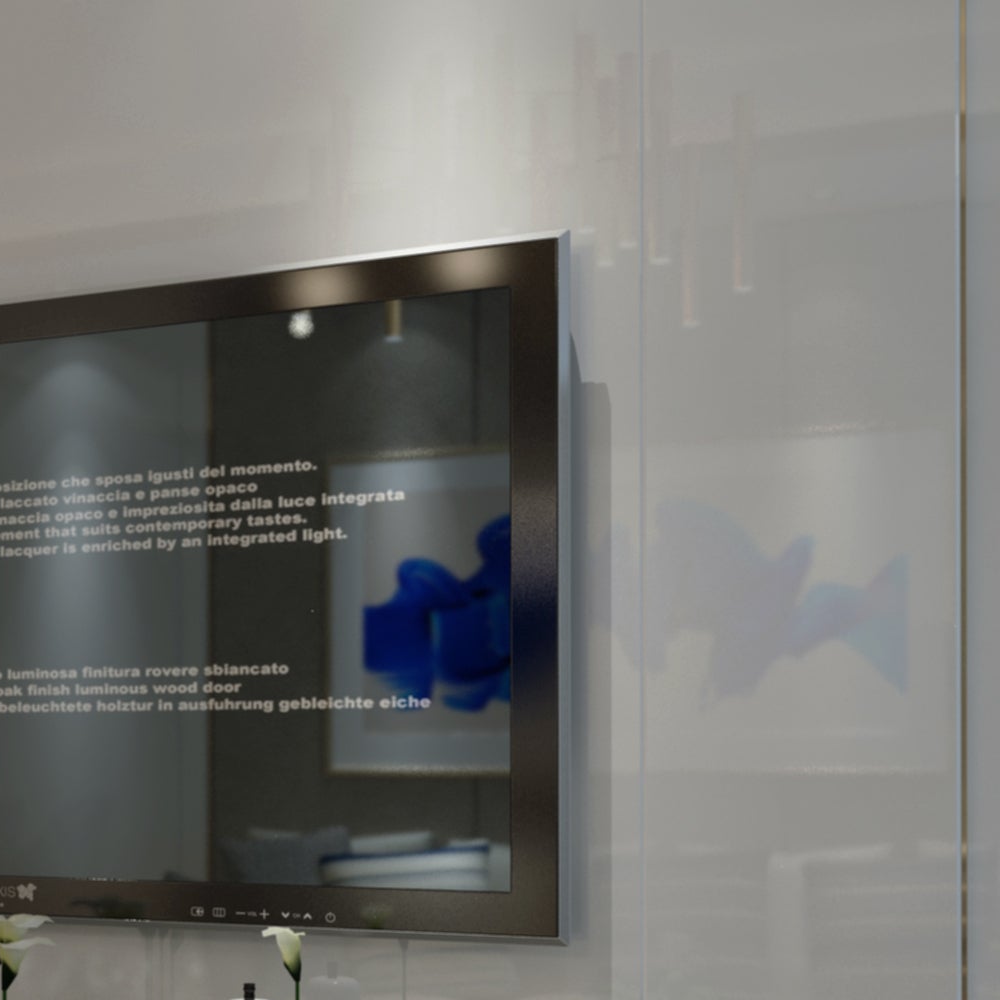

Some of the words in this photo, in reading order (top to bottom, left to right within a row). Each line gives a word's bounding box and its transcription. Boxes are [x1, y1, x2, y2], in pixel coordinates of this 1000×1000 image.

[62, 476, 90, 488] che
[95, 473, 143, 488] sposa
[199, 466, 226, 479] del
[230, 461, 318, 477] momento.
[0, 496, 58, 509] laccato
[63, 490, 130, 504] vinaccia
[135, 490, 145, 500] e
[150, 486, 200, 502] panse
[205, 482, 258, 498] opaco
[55, 510, 103, 524] opaco
[108, 509, 118, 519] e
[123, 501, 225, 519] impreziosita
[230, 498, 273, 512] dalla
[278, 496, 316, 508] luce
[321, 490, 405, 506] integrata
[45, 525, 76, 538] that
[82, 524, 121, 536] suits
[125, 517, 243, 534] contemporary
[246, 513, 308, 527] tastes.
[0, 545, 59, 558] lacquer
[63, 542, 76, 554] is
[81, 538, 152, 552] enriched
[157, 537, 177, 552] by
[181, 537, 202, 548] an
[207, 530, 298, 547] integrated
[302, 528, 348, 544] light.
[7, 668, 77, 680] luminosa
[82, 666, 140, 678] finitura
[145, 667, 198, 677] rovere
[203, 663, 289, 676] sbiancato
[28, 684, 70, 696] finish
[75, 683, 148, 695] luminous
[152, 682, 198, 694] wood
[202, 681, 242, 693] door
[96, 700, 154, 712] holztur
[158, 700, 173, 711] in
[178, 699, 274, 713] ausfuhrung
[278, 698, 374, 713] gebleichte
[380, 698, 431, 709] eiche
